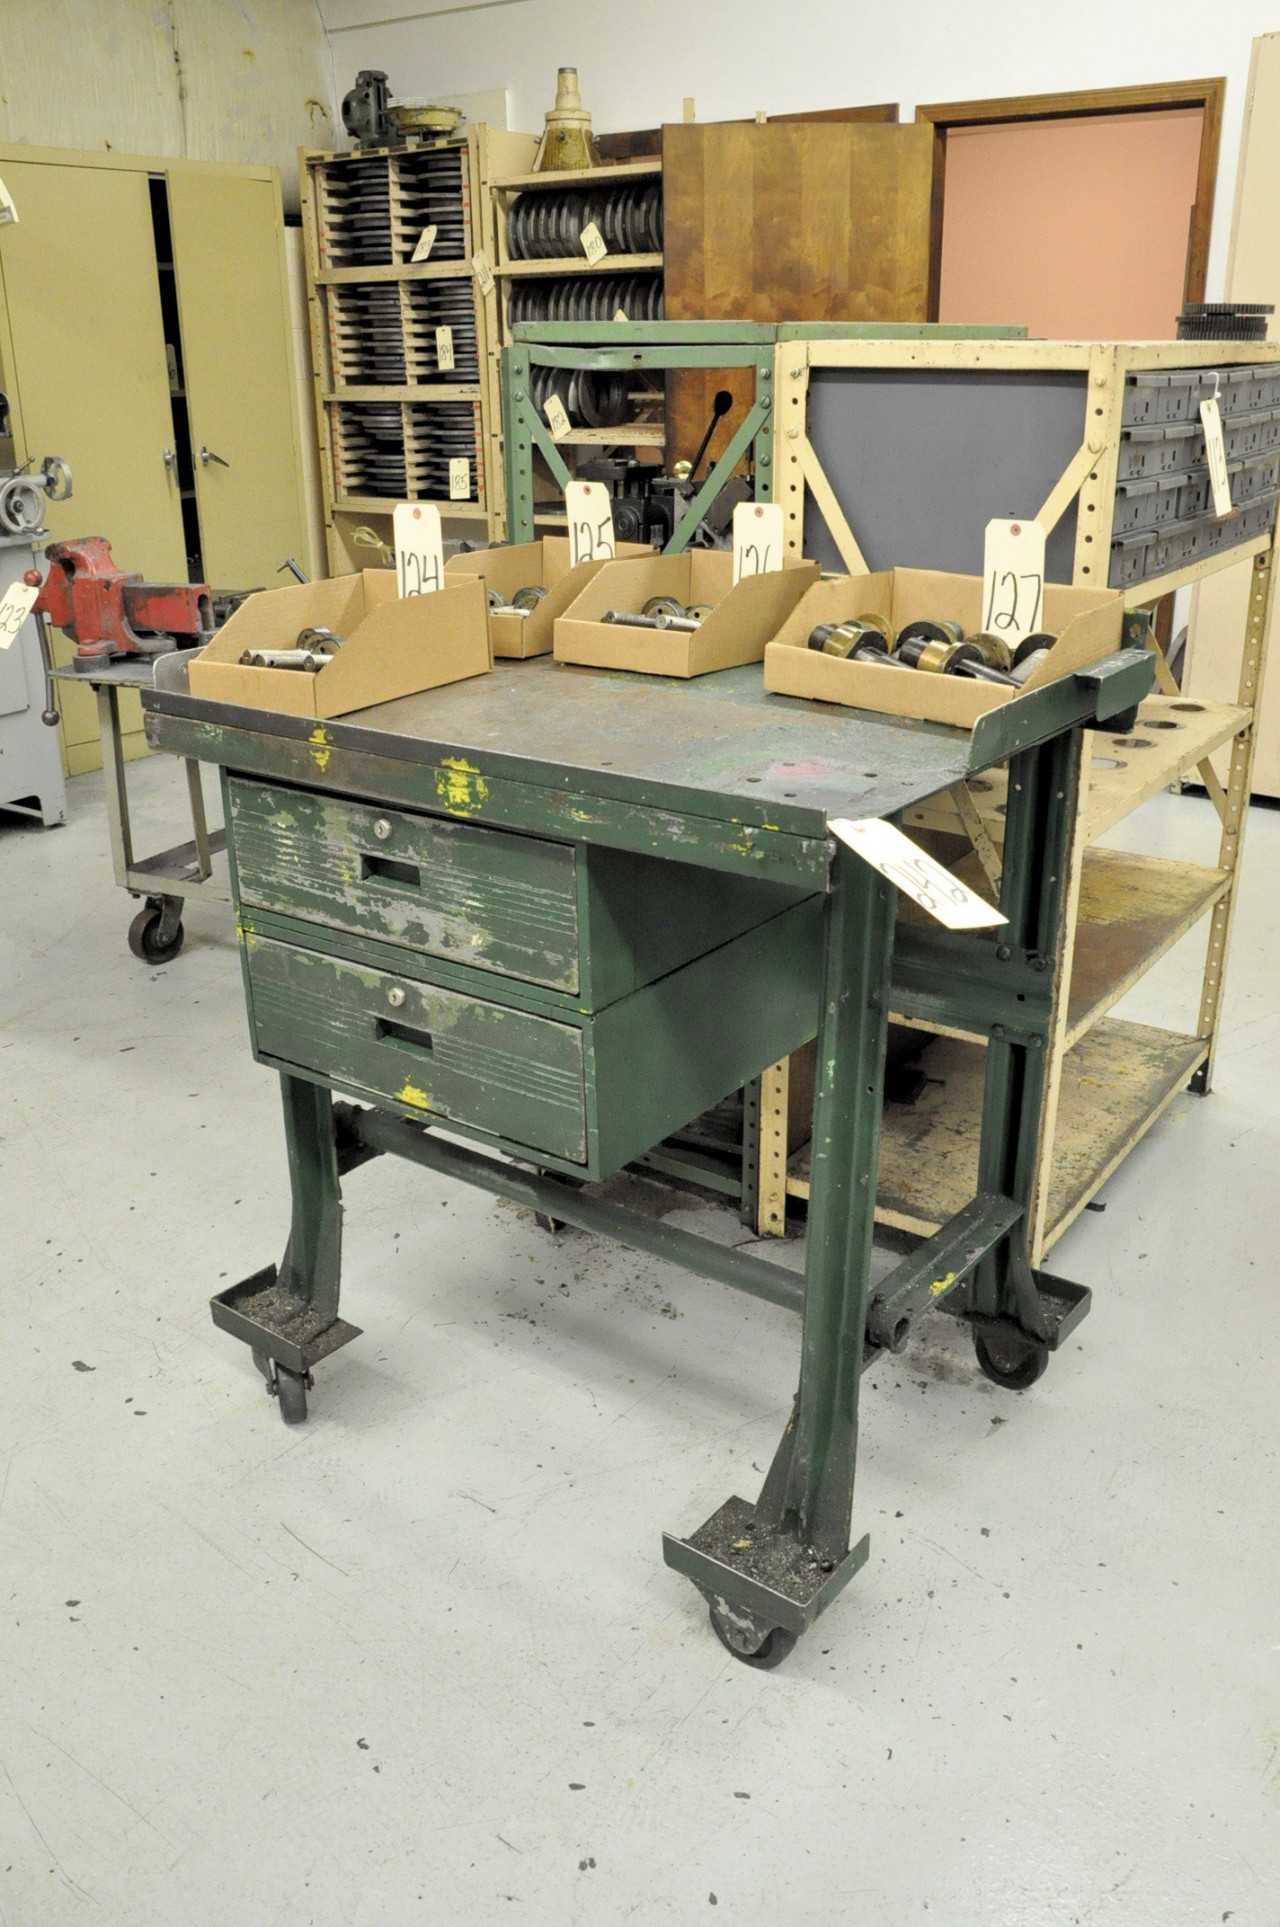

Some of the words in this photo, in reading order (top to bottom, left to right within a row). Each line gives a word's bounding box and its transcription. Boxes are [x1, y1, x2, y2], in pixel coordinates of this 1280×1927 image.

[452, 473, 468, 491] 185
[574, 516, 613, 567] 125
[401, 550, 439, 598] 124
[986, 571, 1041, 633] 127
